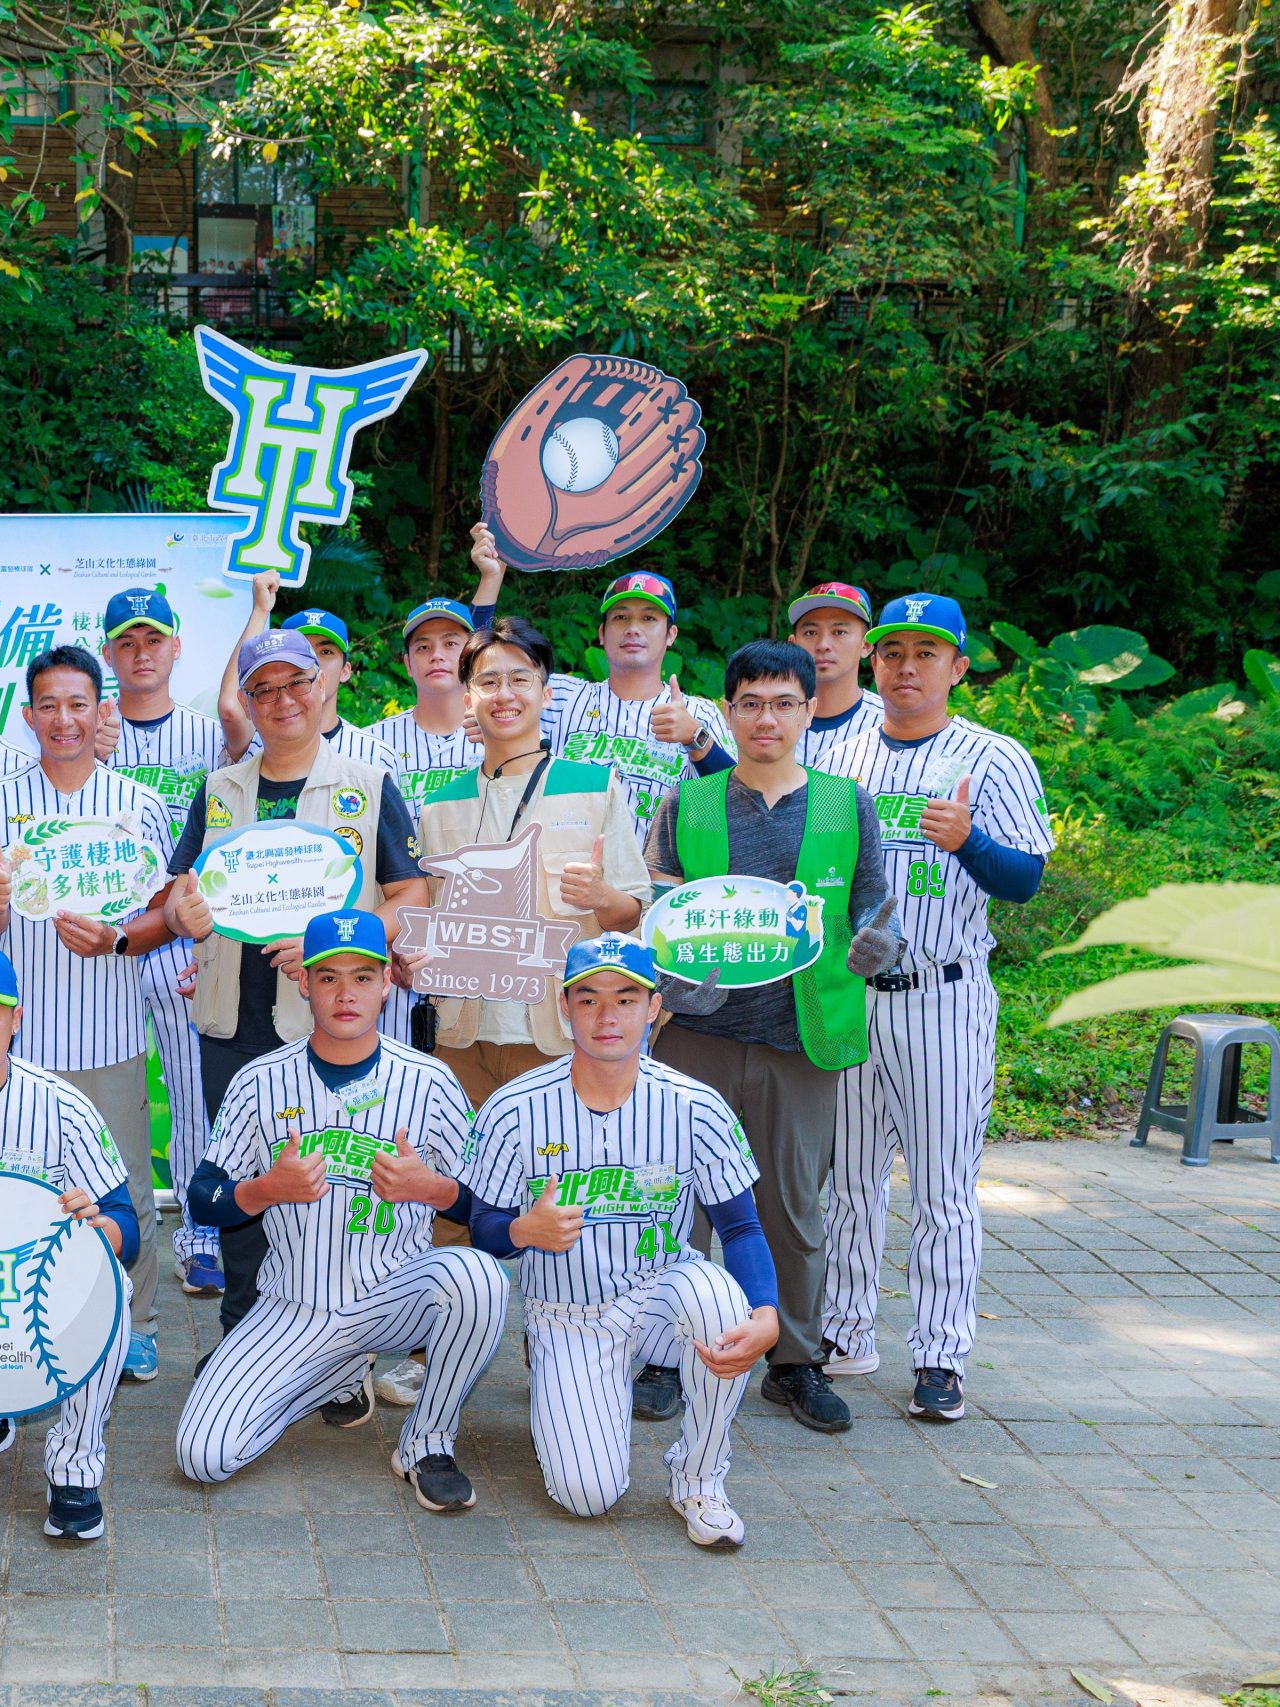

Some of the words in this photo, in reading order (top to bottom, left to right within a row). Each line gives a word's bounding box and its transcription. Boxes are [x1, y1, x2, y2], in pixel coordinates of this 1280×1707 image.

[75, 557, 157, 569] 芝山文化生態綠園
[256, 638, 284, 651] WBST
[34, 838, 139, 873] 守護棲地
[246, 843, 323, 861] 臺北興富發棒球隊
[246, 862, 265, 870] Taipei
[265, 857, 303, 869] Highwealth
[51, 869, 129, 901] 多樣性
[907, 860, 946, 899] 89
[230, 886, 326, 907] 芝山文化生態綠園
[272, 904, 283, 913] and
[684, 907, 780, 930] 揮汗綠動
[439, 920, 535, 950] WBST
[419, 966, 480, 992] Since
[489, 973, 540, 998] 1973
[347, 1194, 397, 1236] 20
[592, 1203, 625, 1215] HIGH
[629, 1202, 673, 1213] WELTH
